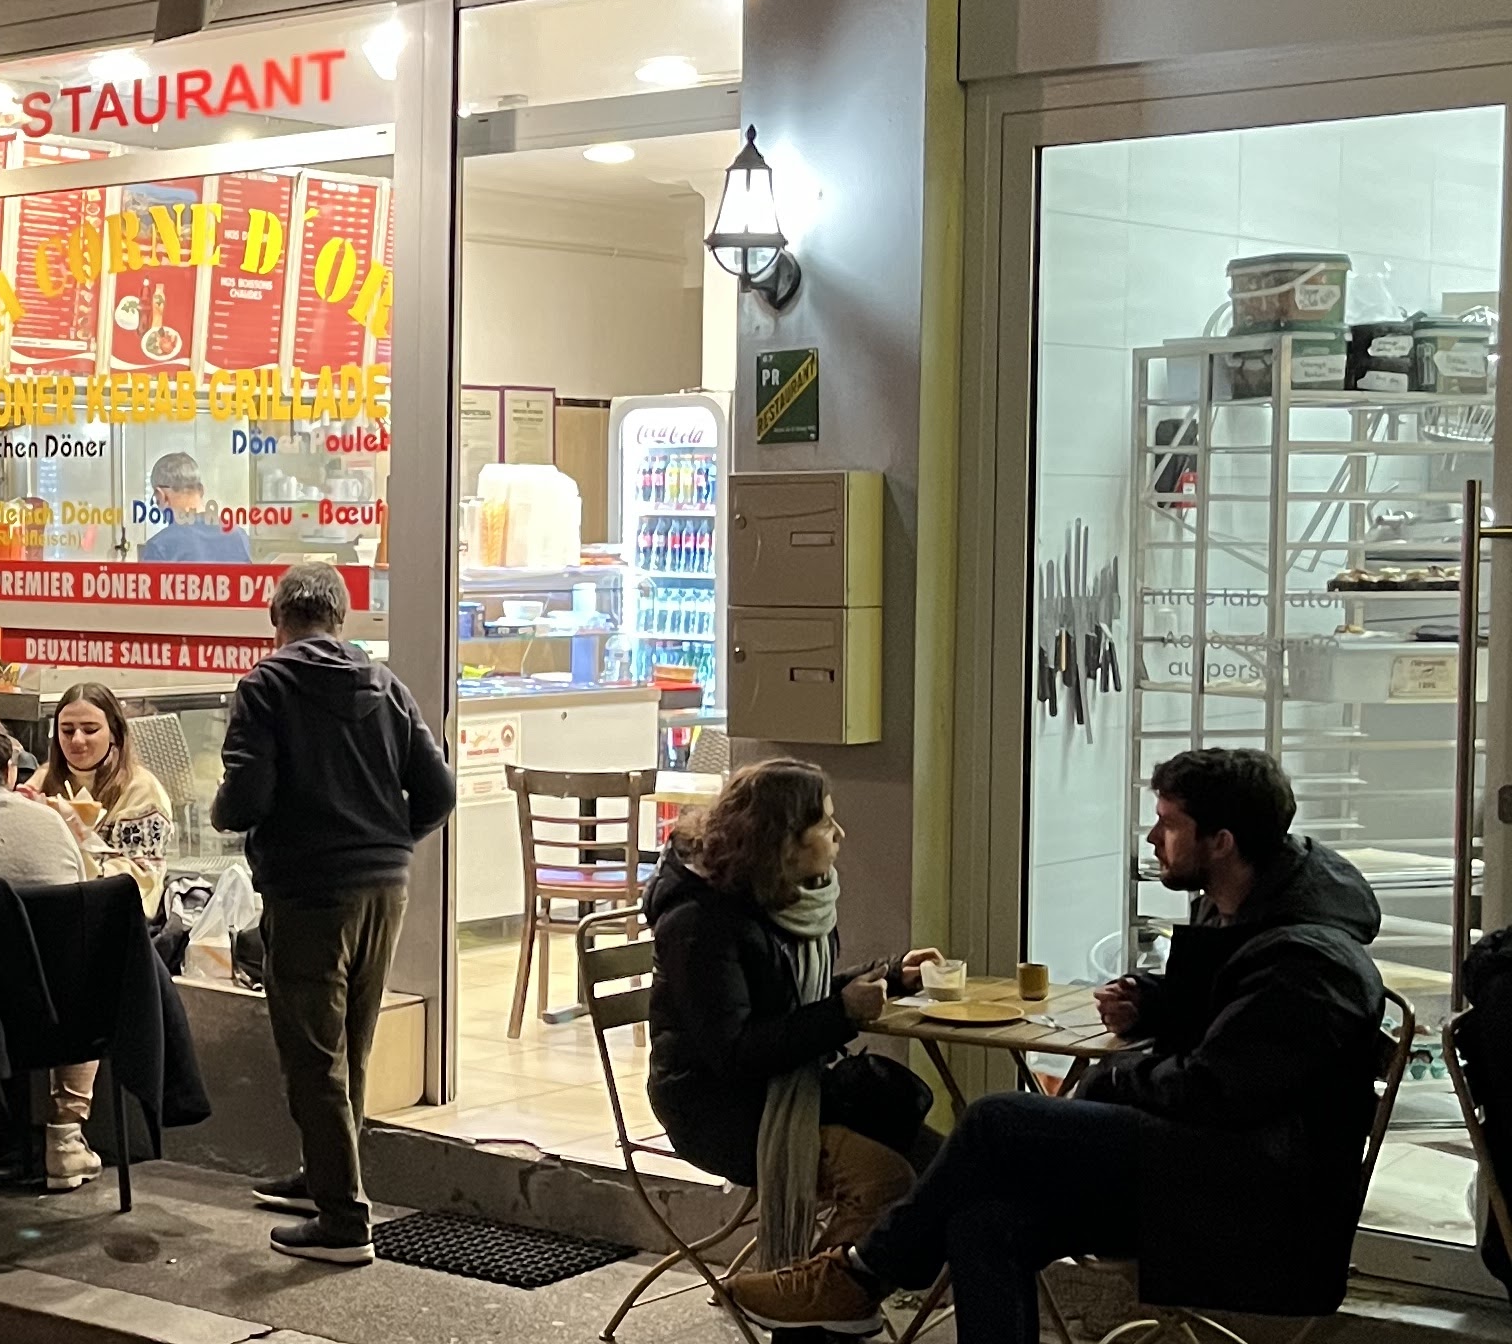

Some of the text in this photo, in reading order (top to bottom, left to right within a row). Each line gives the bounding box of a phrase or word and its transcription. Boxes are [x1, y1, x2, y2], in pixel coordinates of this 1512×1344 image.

[34, 202, 224, 299] CORNE
[761, 368, 780, 387] PR
[87, 369, 197, 424] KEBAB
[757, 358, 815, 436] RESTAURANT
[45, 434, 107, 458] Döner
[232, 428, 303, 455] Döner
[61, 499, 122, 525] Döner
[204, 499, 293, 534] Agneau
[82, 565, 152, 600] DÖNER
[159, 573, 231, 602] KEBAB
[239, 574, 278, 603] D'A
[25, 633, 114, 664] DEUXIÈME
[119, 640, 172, 666] SALLE
[197, 639, 277, 670] L'ARRIÈ
